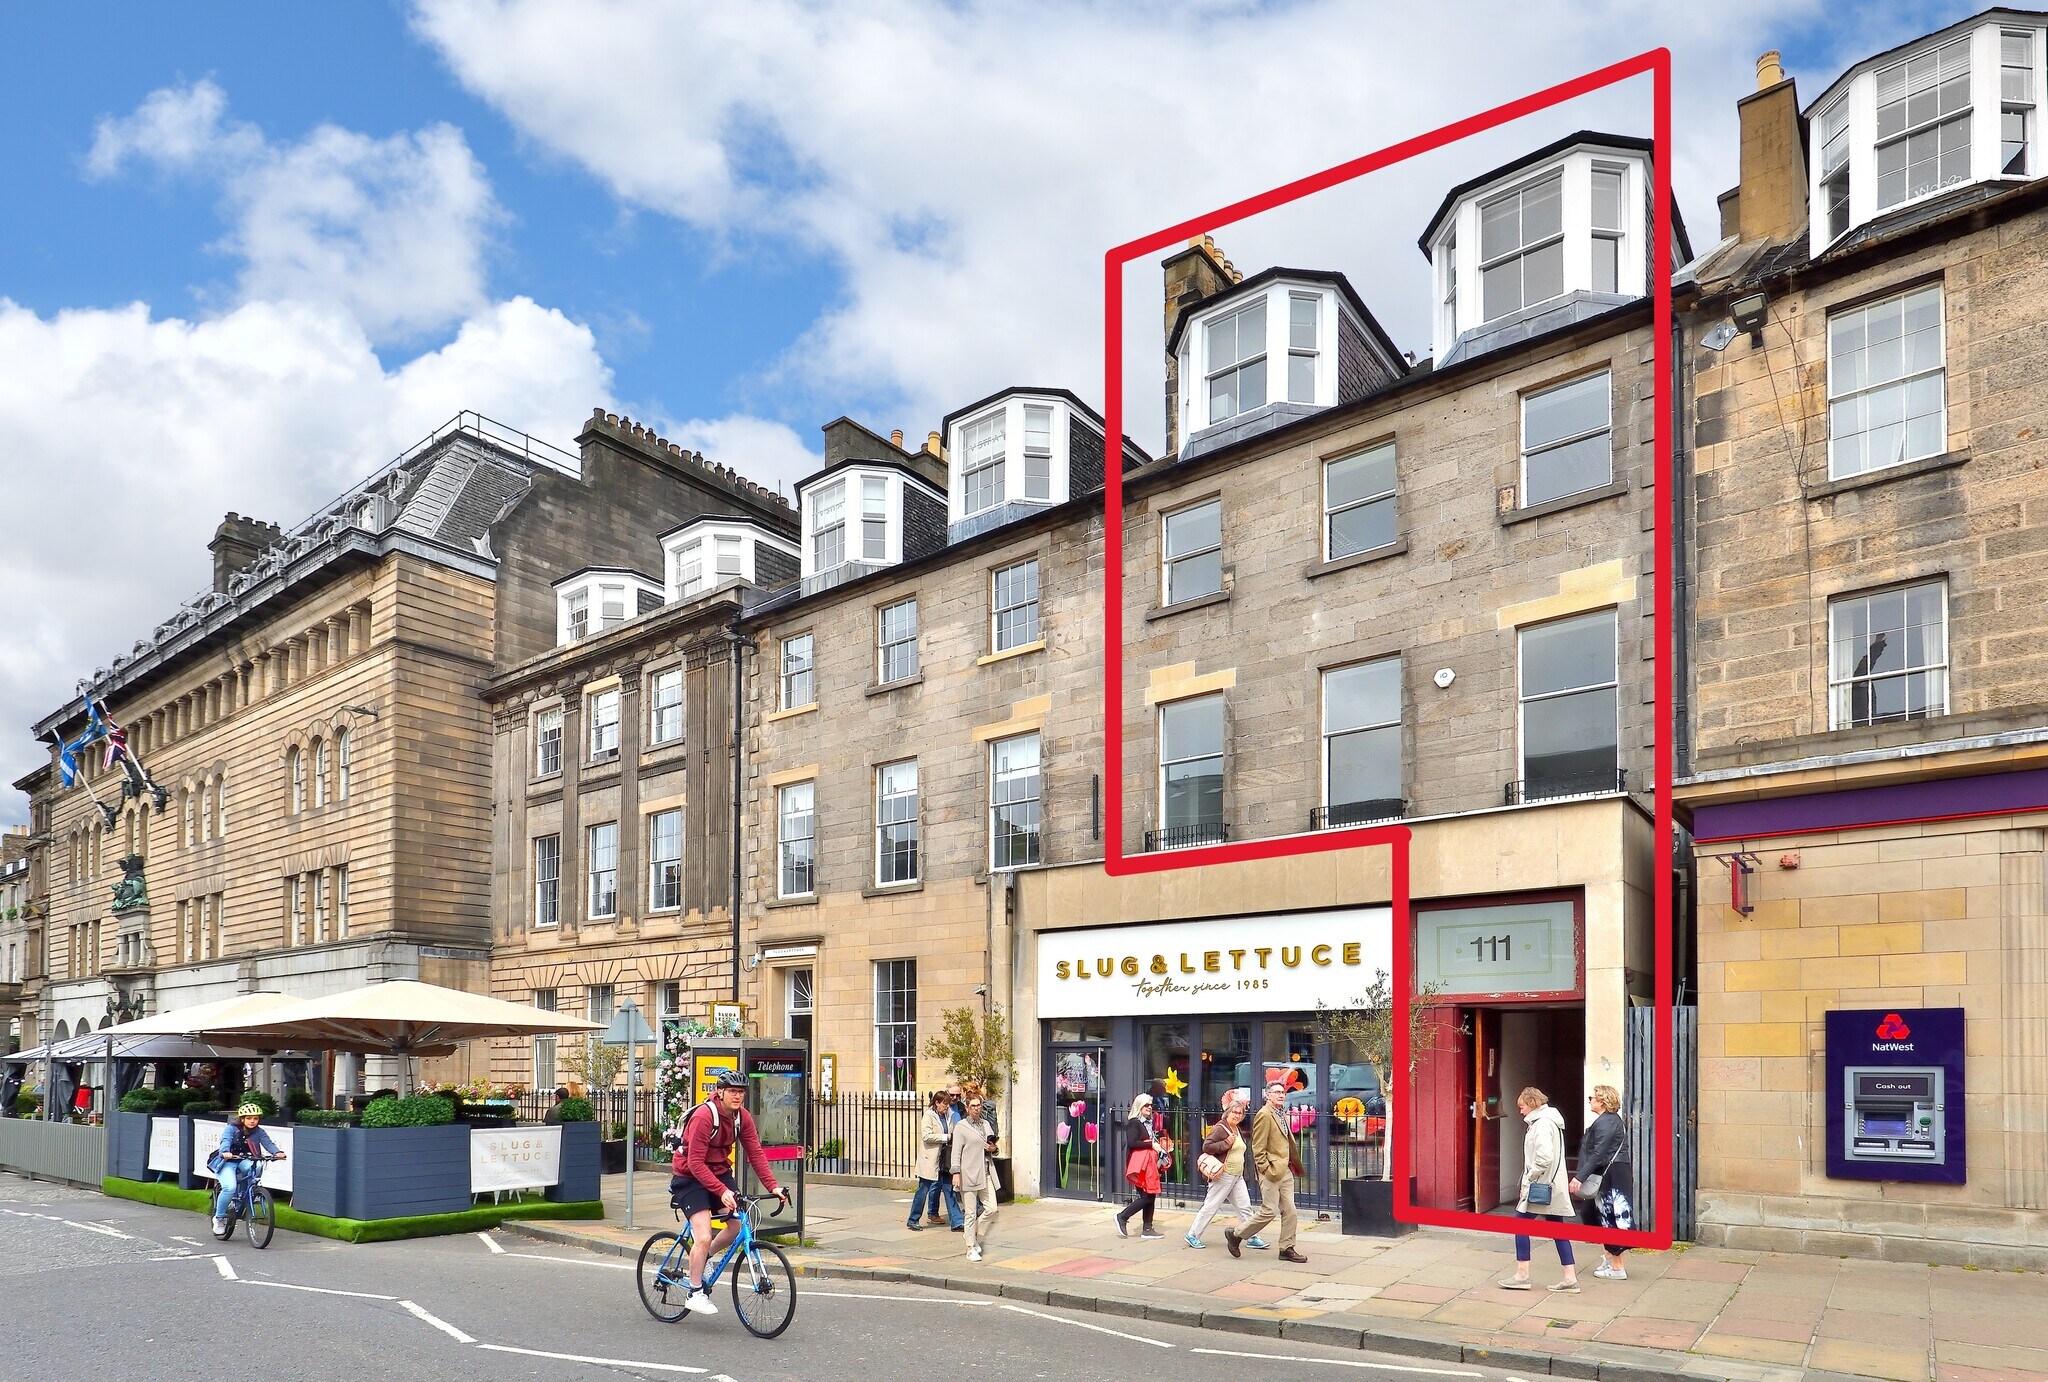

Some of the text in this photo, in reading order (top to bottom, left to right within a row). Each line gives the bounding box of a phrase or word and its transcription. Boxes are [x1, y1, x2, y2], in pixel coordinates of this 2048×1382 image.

[1470, 935, 1511, 962] 111
[1056, 942, 1362, 979] SLUG & LETTUCE
[1131, 976, 1269, 997] together since 1985
[1872, 1043, 1914, 1051] NatWest
[757, 1061, 794, 1072] Telephone
[489, 1141, 530, 1150] SLUG
[481, 1151, 552, 1164] LETTUCE
